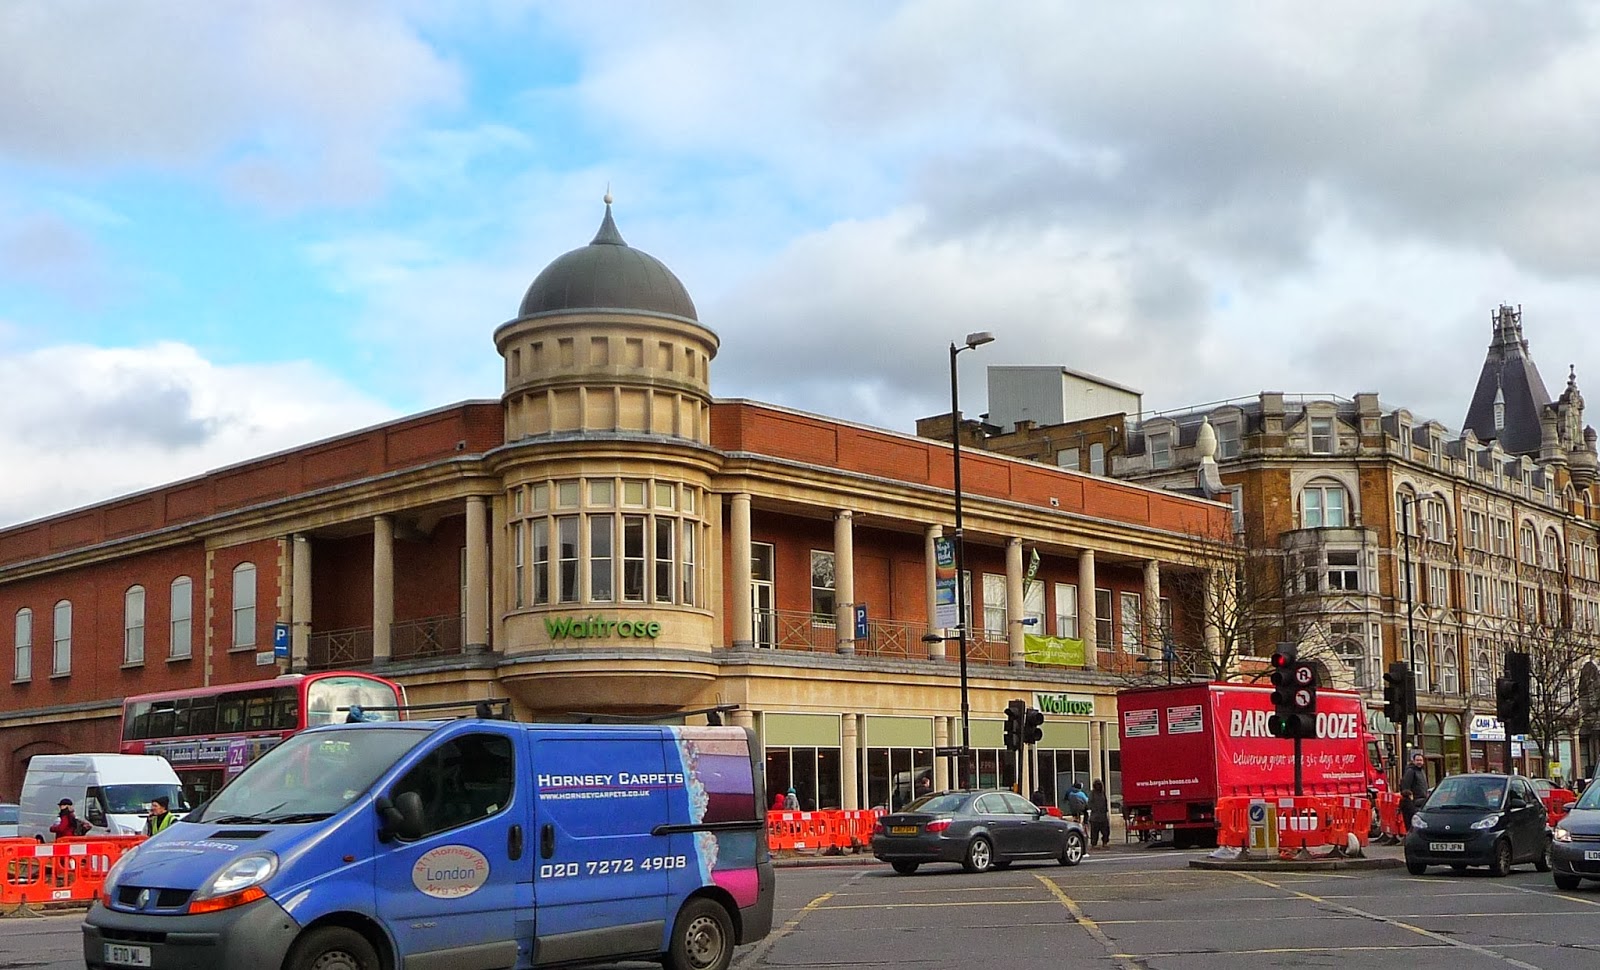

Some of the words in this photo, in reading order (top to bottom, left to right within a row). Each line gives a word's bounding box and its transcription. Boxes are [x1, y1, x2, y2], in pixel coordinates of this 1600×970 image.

[544, 613, 661, 640] Waitrose
[277, 629, 286, 640] P
[1037, 694, 1093, 714] Waitrose
[1233, 750, 1268, 770] Delivering
[538, 774, 613, 787] HORNSEY
[619, 772, 684, 785] CARPETS
[539, 790, 650, 800] WWW.HORNSEYCARPETS.CO.UK
[193, 840, 239, 852] CARPETS
[430, 848, 476, 860] Hornsey
[540, 864, 579, 878] 020
[586, 859, 634, 875] 7272
[641, 855, 686, 870] 4908
[426, 867, 475, 881] London
[426, 883, 448, 895] N19
